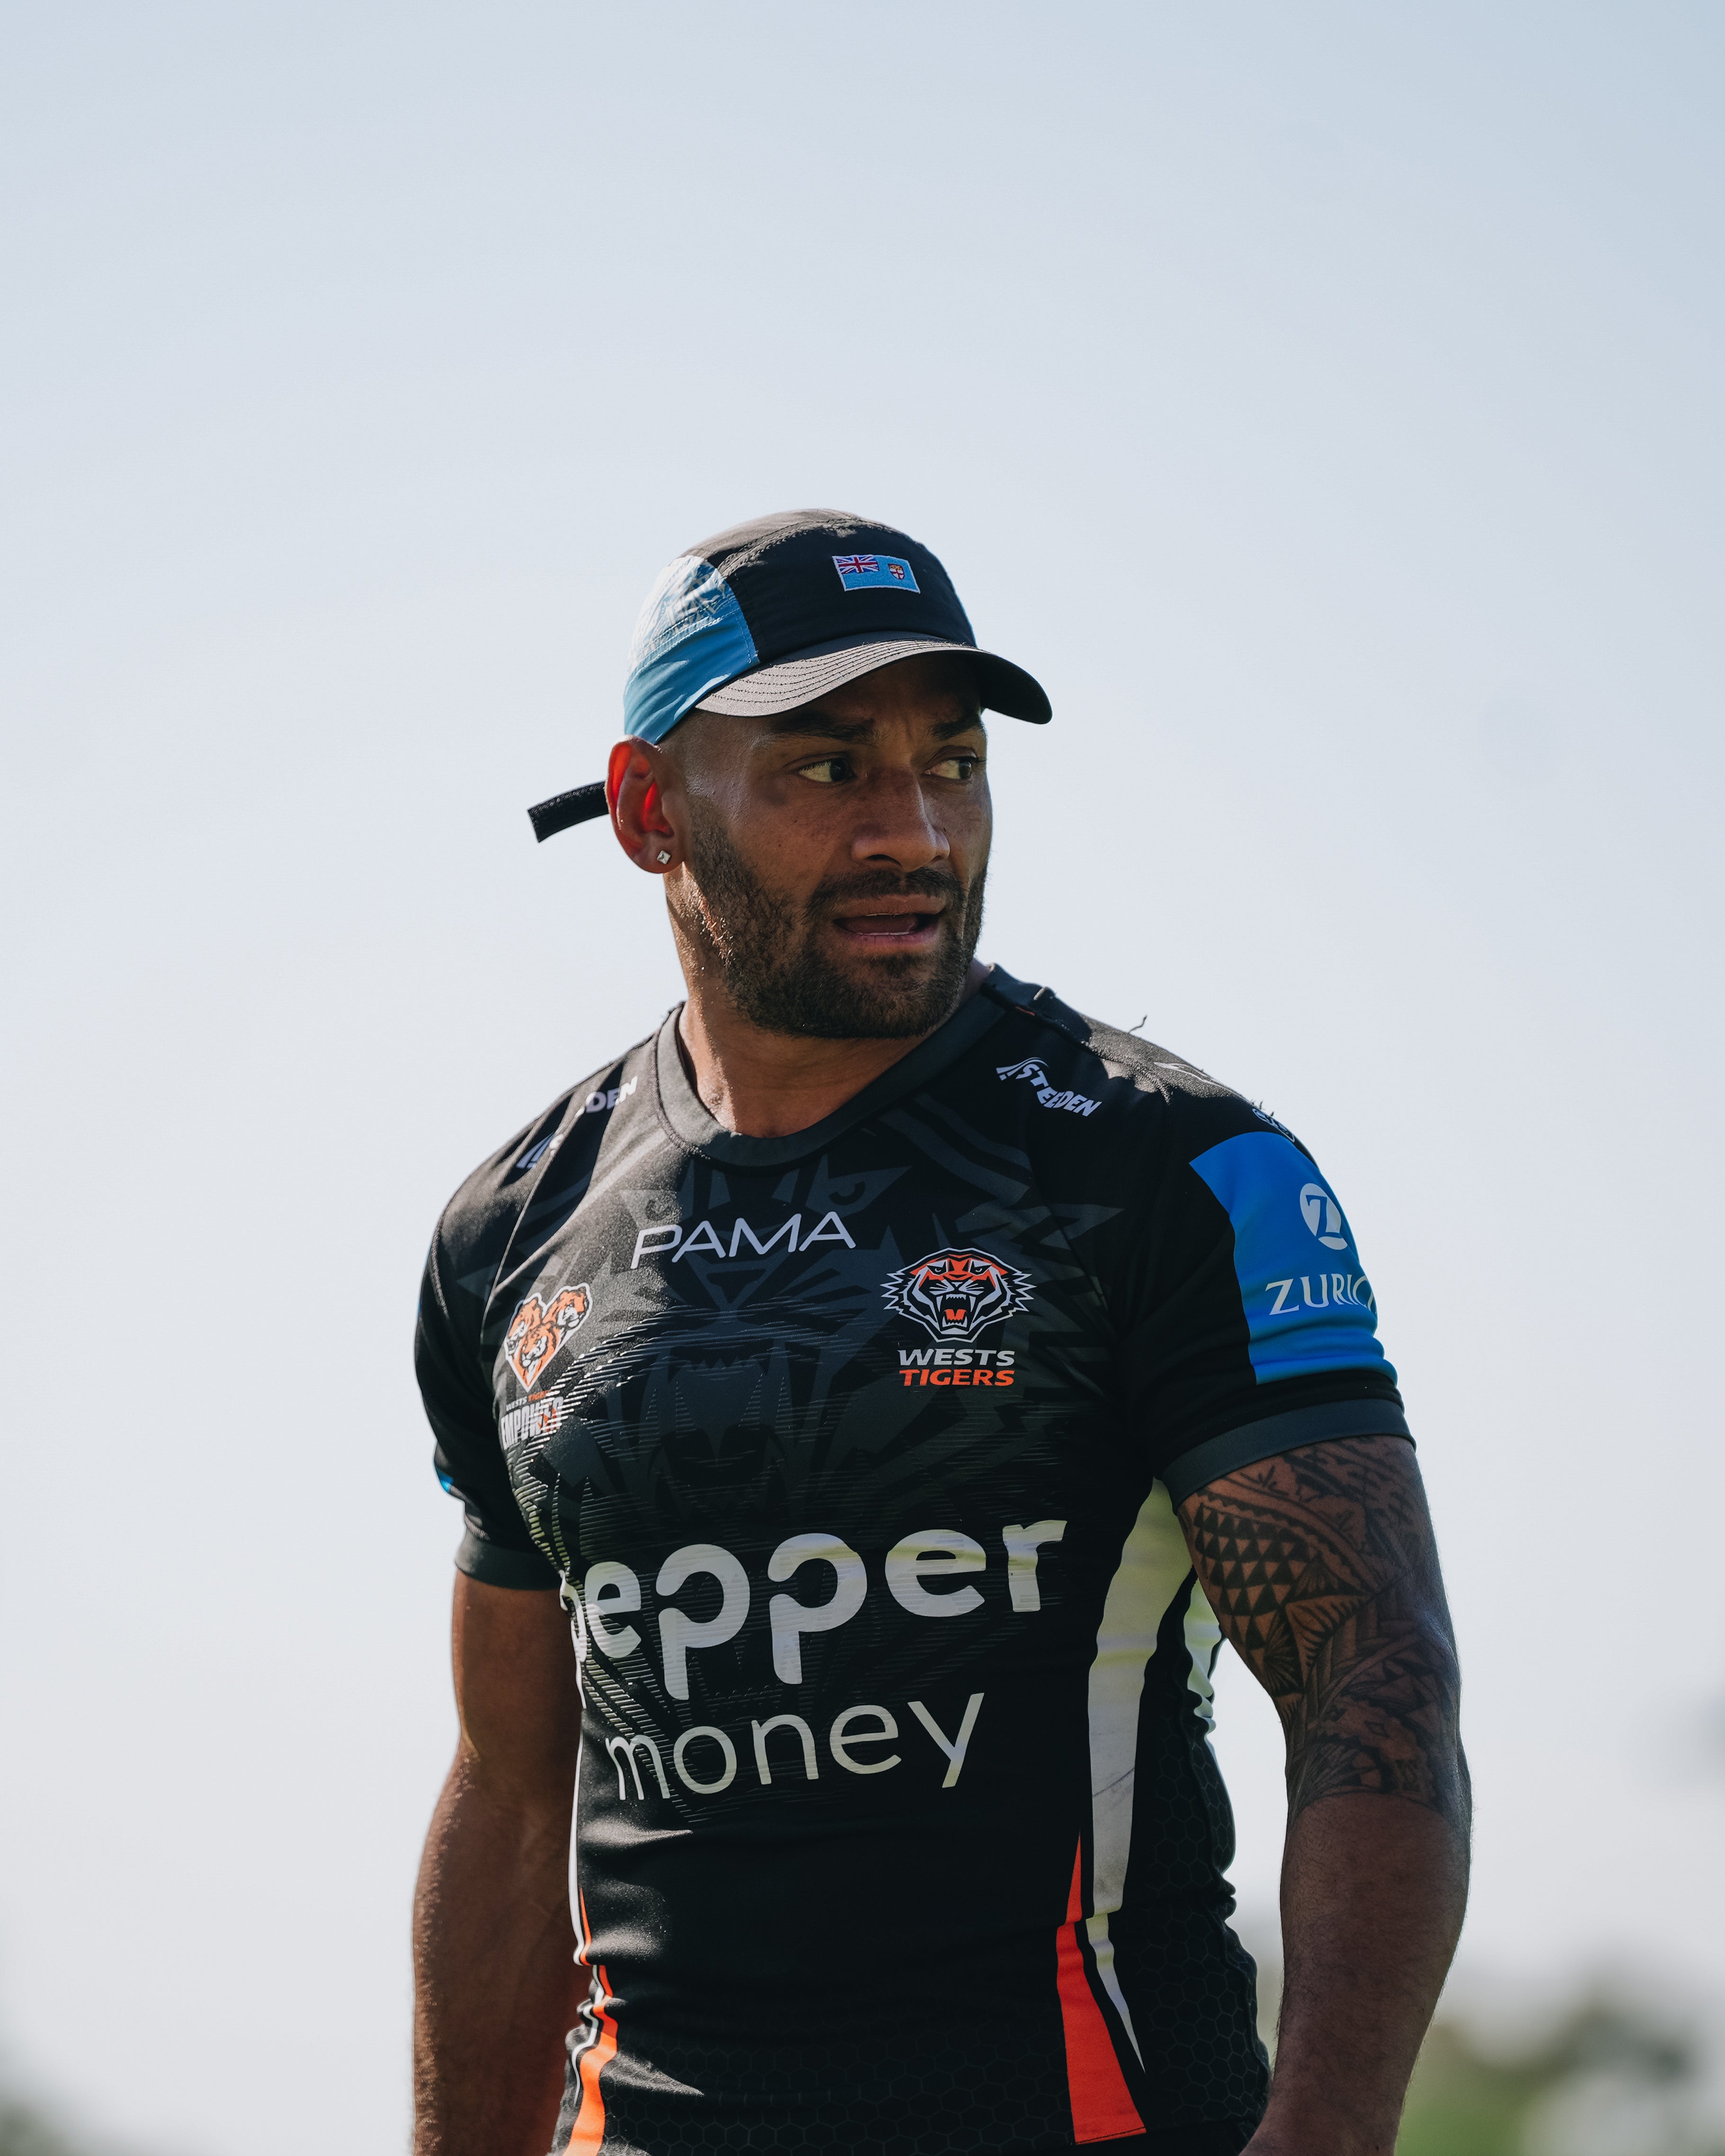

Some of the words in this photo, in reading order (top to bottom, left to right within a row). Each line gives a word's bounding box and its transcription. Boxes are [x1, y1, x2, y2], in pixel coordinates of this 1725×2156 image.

[630, 1211, 856, 1269] PAMA
[897, 1348, 1015, 1366] WESTS
[898, 1368, 1015, 1386] TIGERS
[506, 1396, 528, 1412] WESTS
[605, 1692, 985, 1801] money
